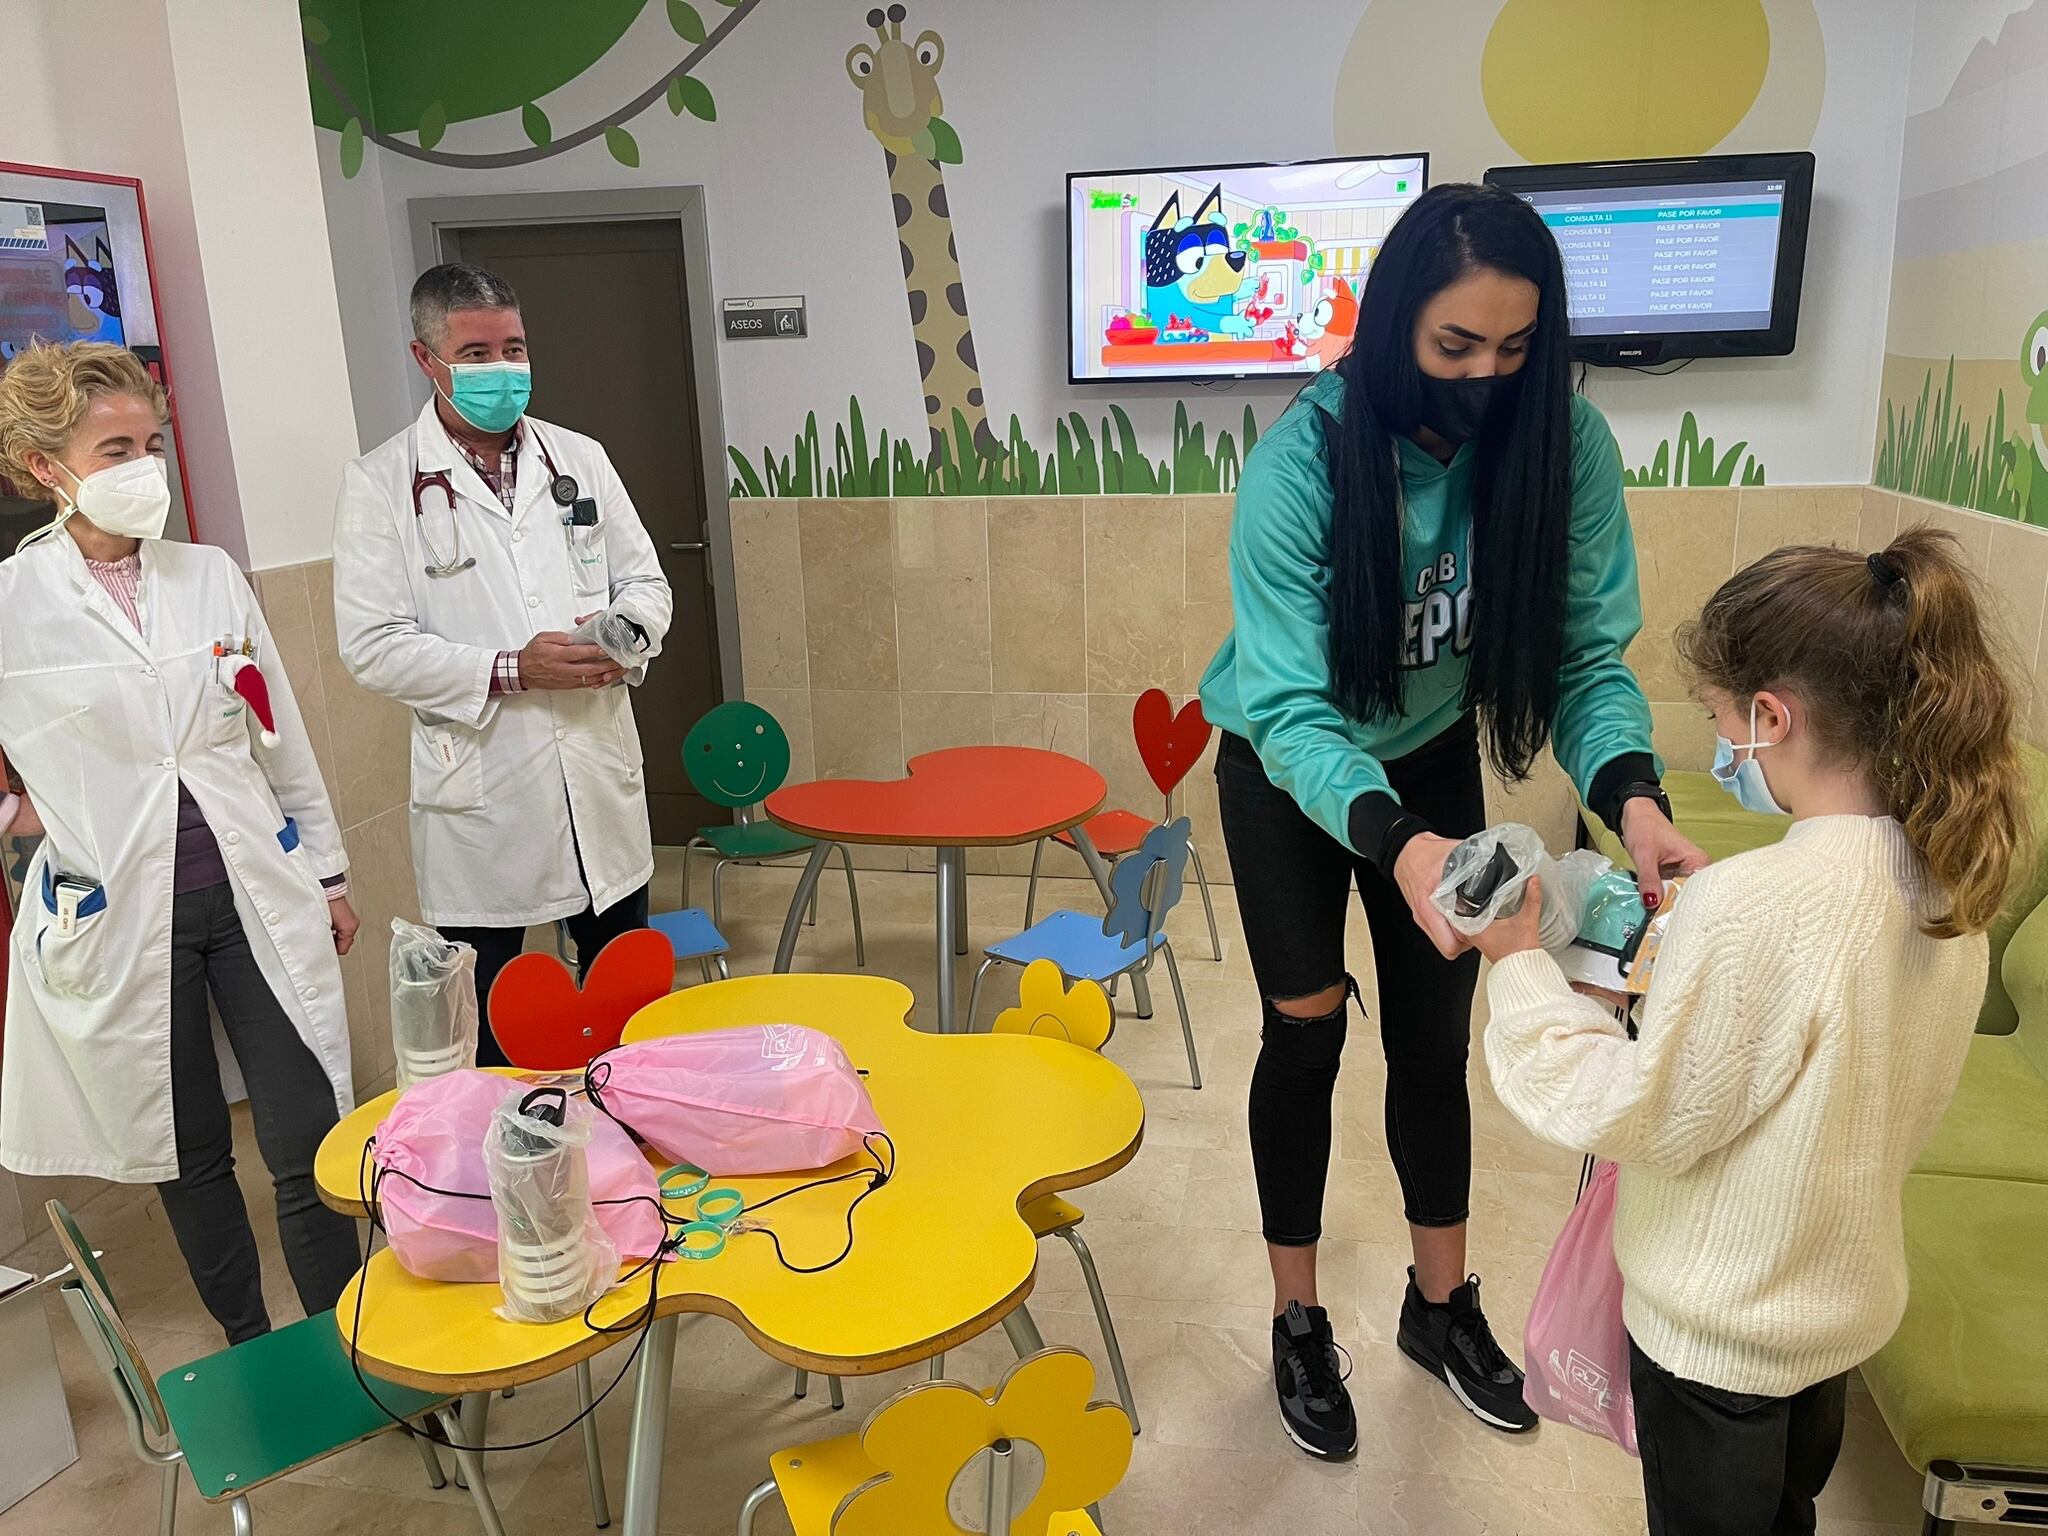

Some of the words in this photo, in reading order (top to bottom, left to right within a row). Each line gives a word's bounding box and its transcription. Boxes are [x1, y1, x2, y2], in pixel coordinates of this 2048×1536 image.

[1564, 214, 1604, 222] CONSULTA
[1564, 228, 1602, 236] CONSULTA
[1563, 241, 1601, 249] CONSULTA
[730, 319, 763, 330] ASEOS
